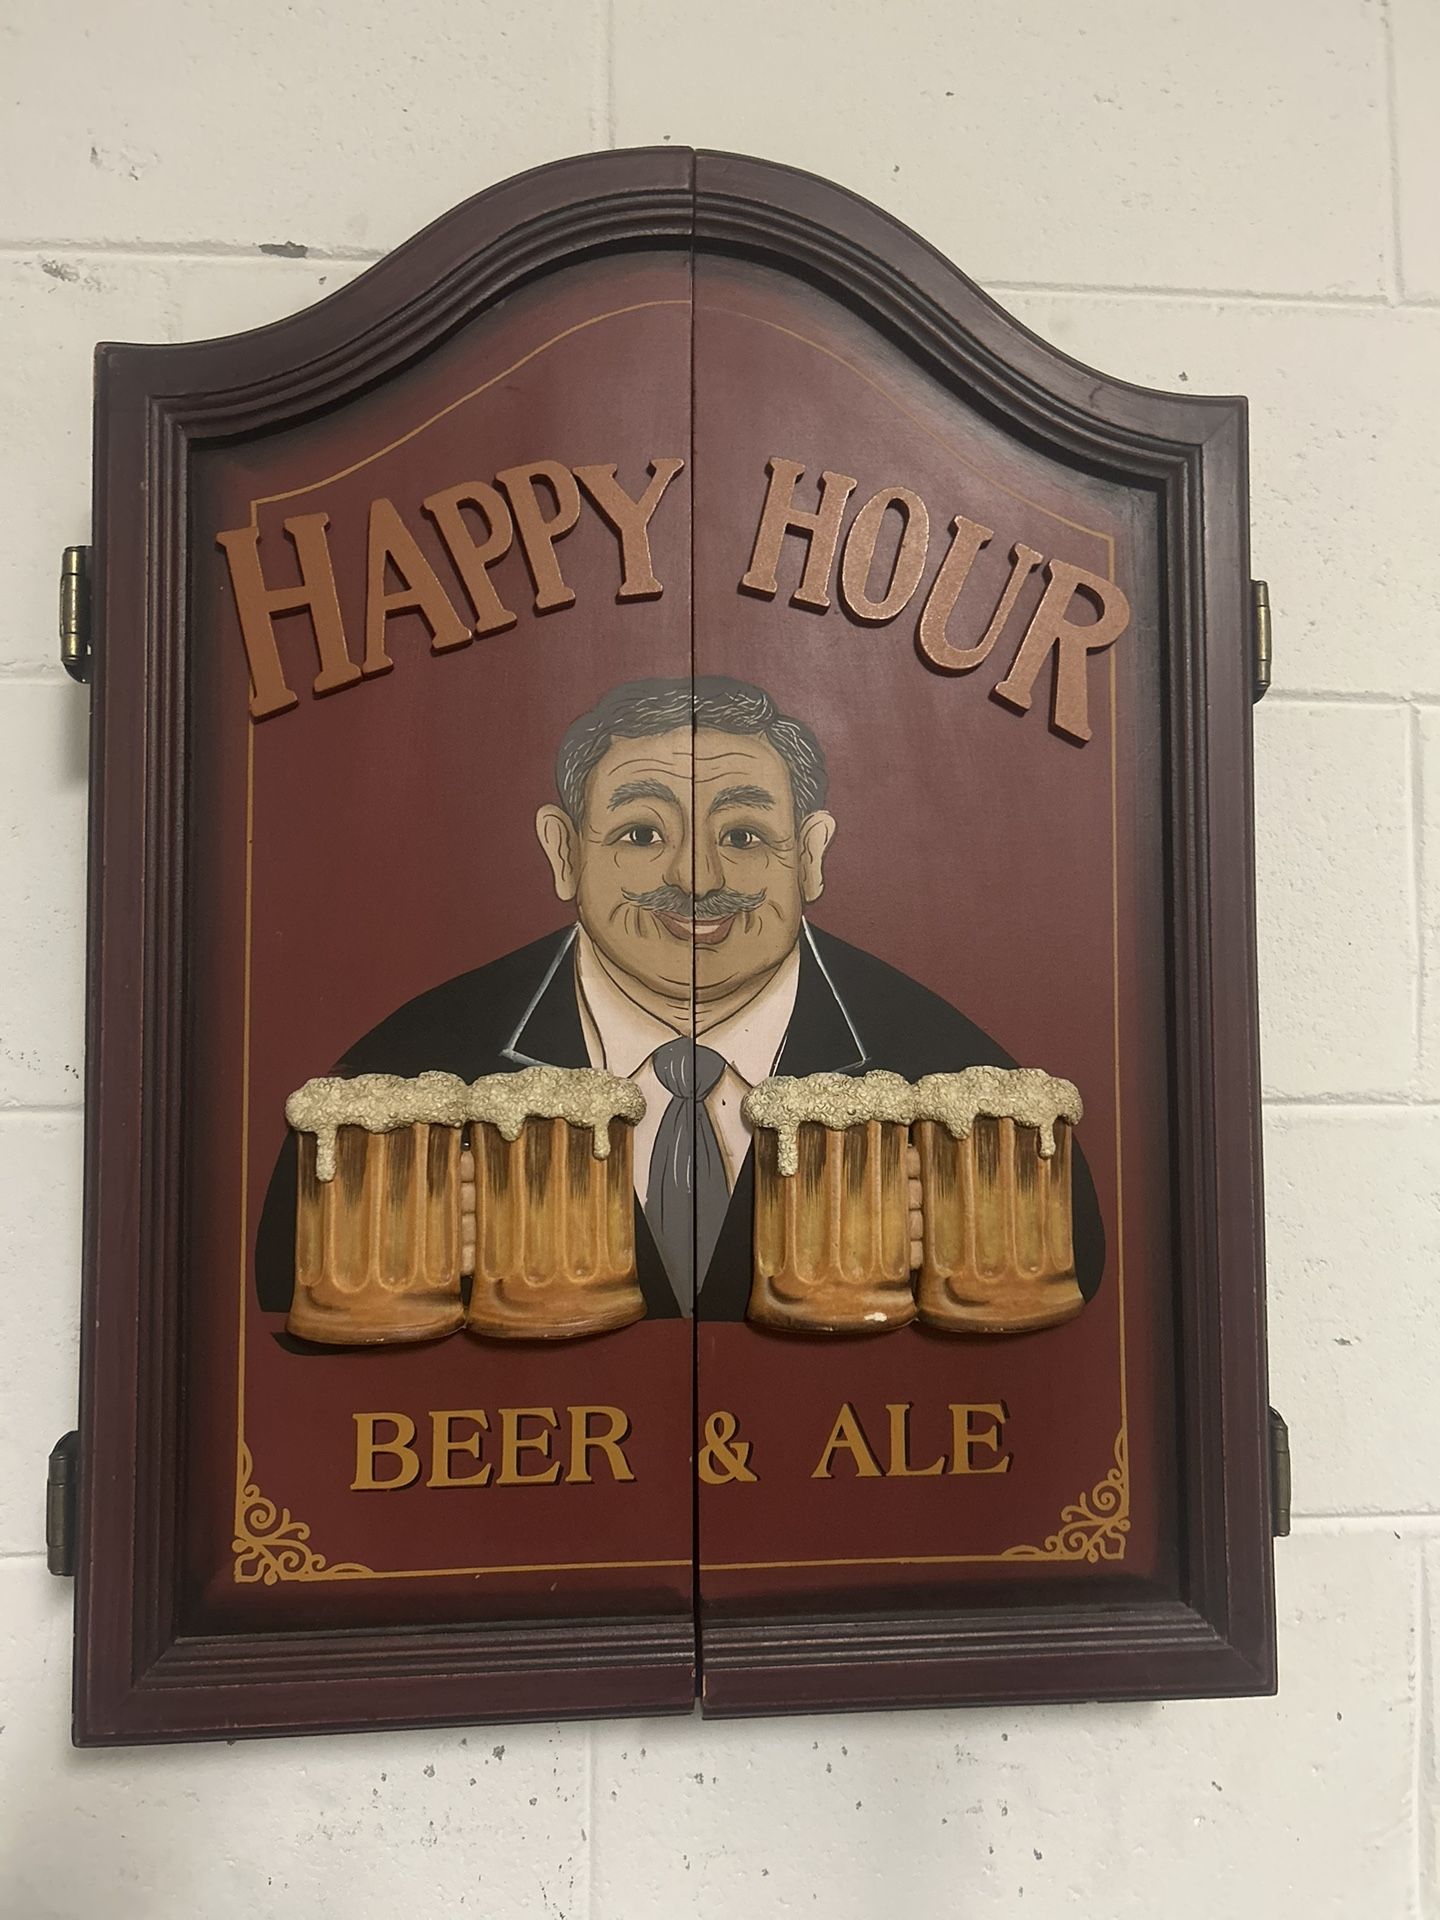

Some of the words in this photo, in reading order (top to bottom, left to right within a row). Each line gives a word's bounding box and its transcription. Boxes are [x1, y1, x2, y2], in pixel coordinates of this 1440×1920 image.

[216, 457, 685, 720] HAPPY
[740, 456, 1130, 745] HOUR
[350, 1404, 635, 1491] BEER
[697, 1410, 758, 1485] &
[810, 1401, 1011, 1478] ALE
